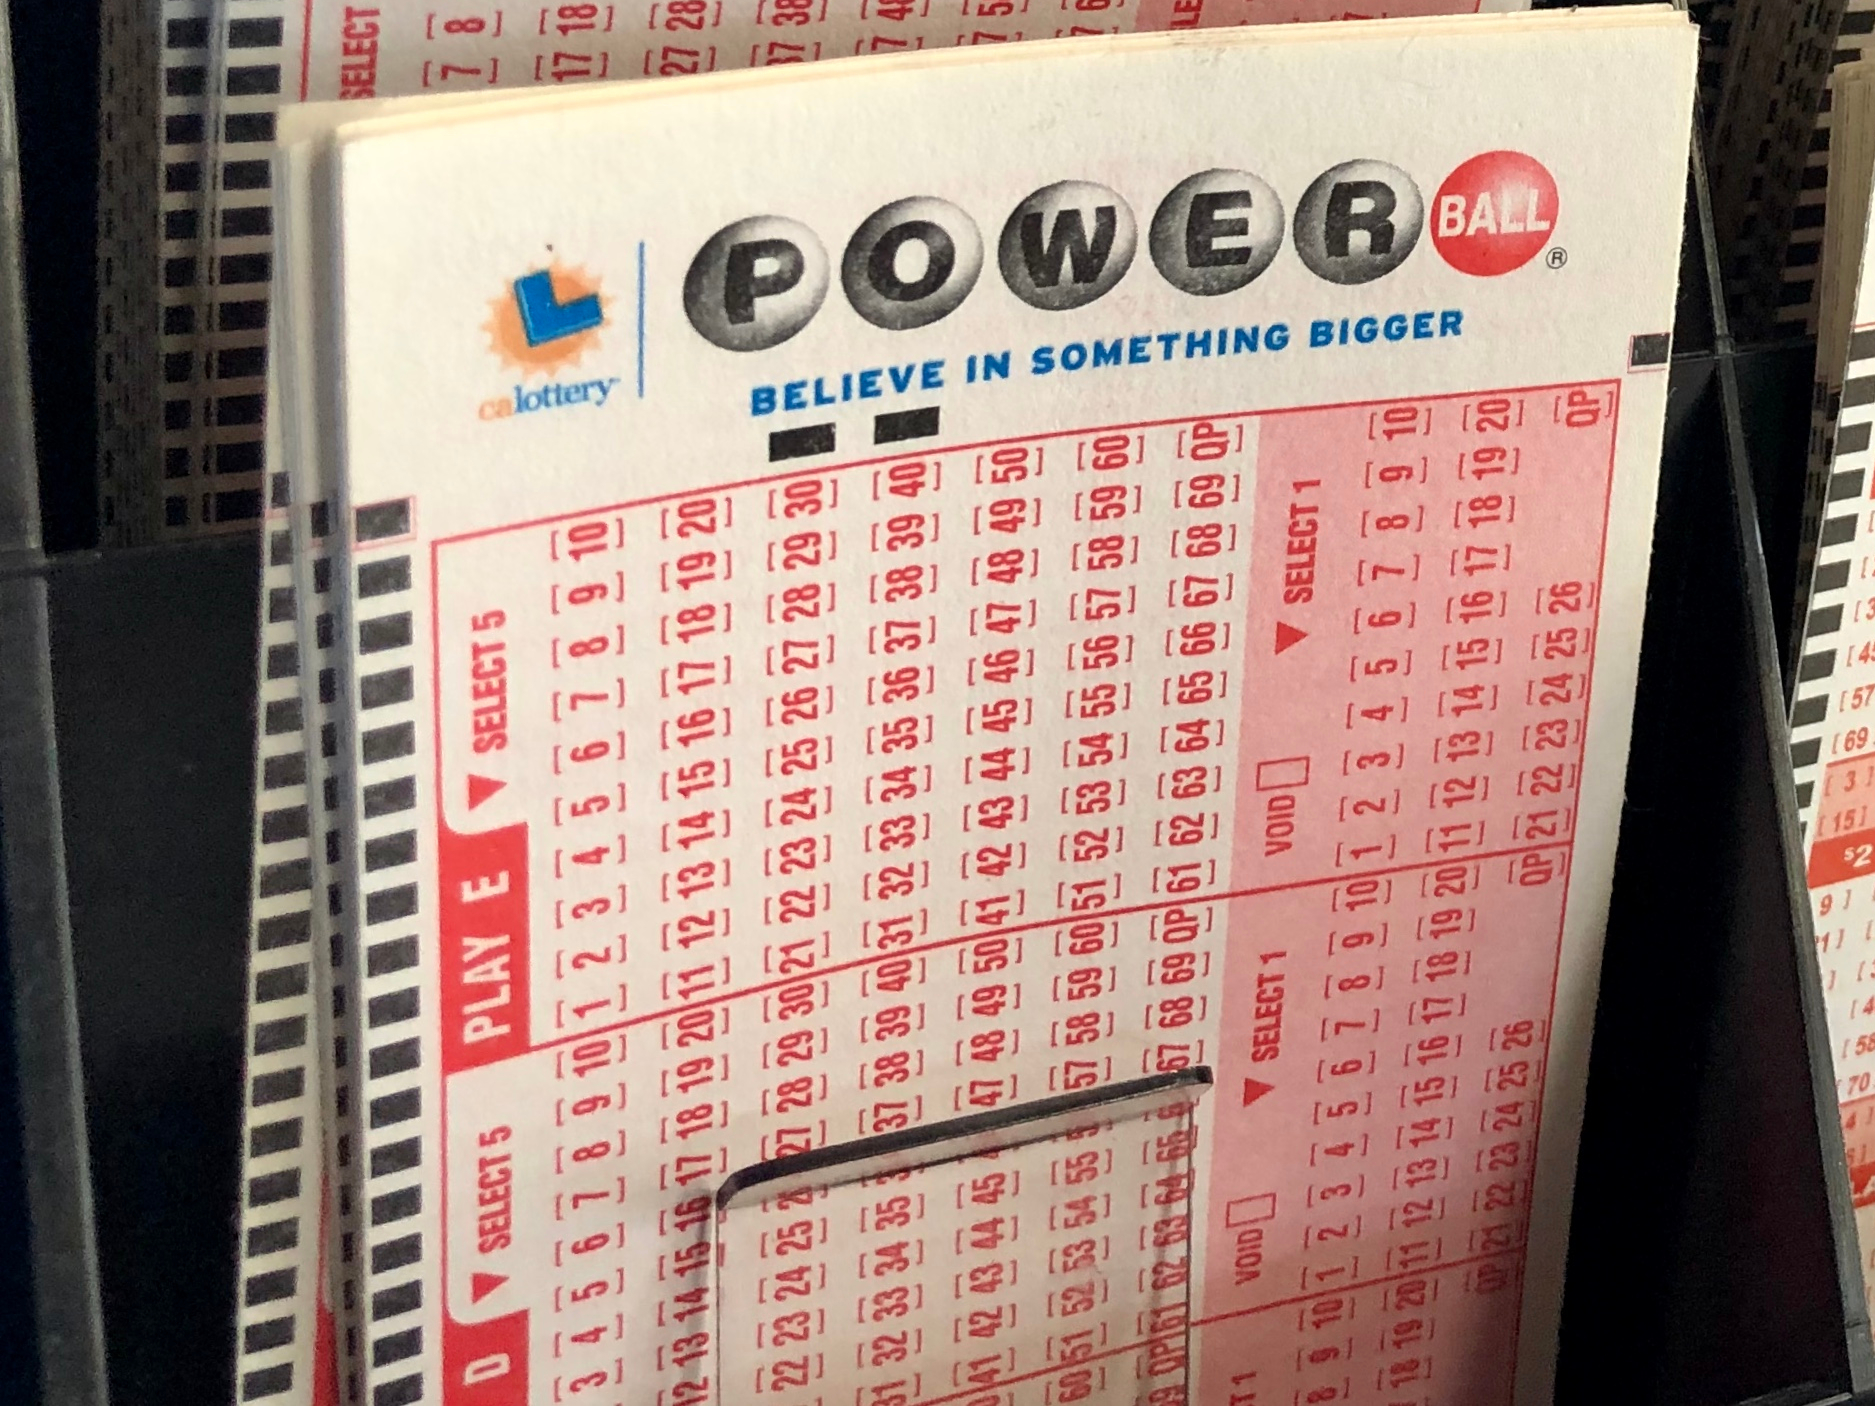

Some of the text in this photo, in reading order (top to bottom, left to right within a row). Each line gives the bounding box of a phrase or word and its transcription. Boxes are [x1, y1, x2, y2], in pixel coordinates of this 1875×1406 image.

[479, 375, 616, 422] calottery
[751, 309, 1464, 418] BELIEVE IN SOMETHING BIGGER
[1284, 478, 1322, 605] SELECT 1
[462, 608, 513, 1045] PLAY E SELECT 5
[1263, 794, 1297, 858] VOID
[1844, 844, 1873, 869] $2
[1252, 950, 1289, 1063] SELECT 1
[479, 1125, 513, 1148] 5
[477, 1151, 514, 1258] SELECT
[1233, 1229, 1265, 1287] VOID
